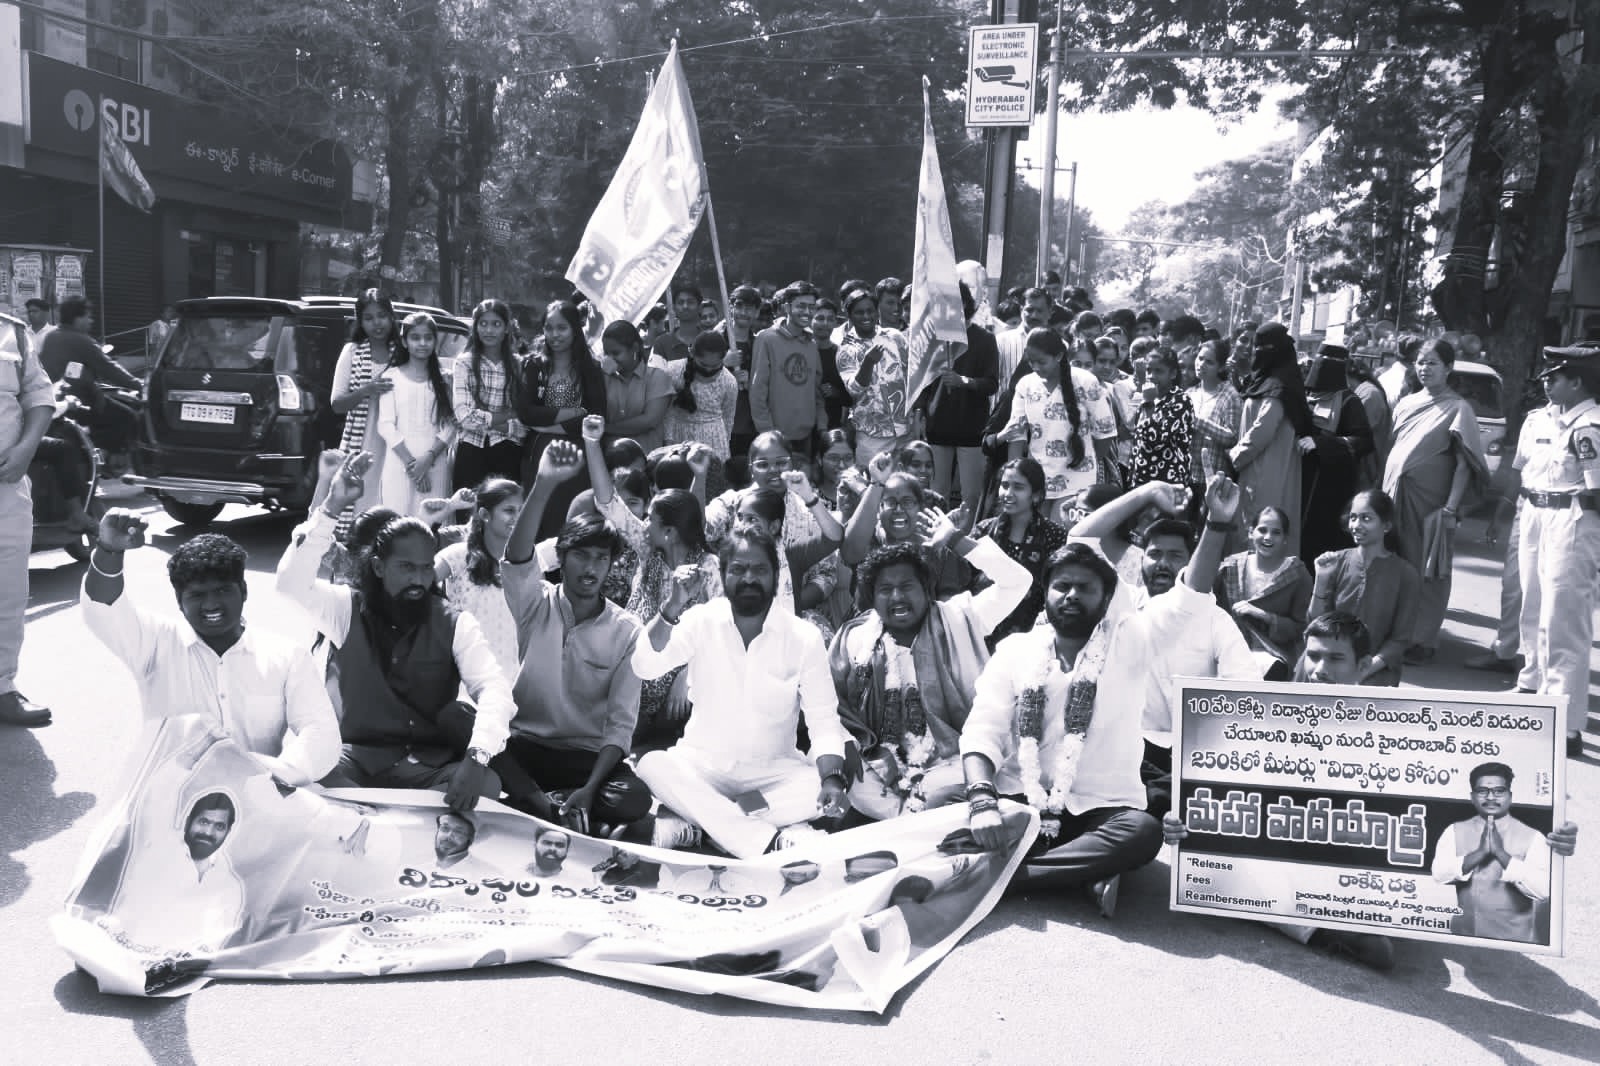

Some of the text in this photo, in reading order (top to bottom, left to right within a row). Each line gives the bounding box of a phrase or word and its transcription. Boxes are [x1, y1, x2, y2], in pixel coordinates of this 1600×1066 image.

[982, 31, 1026, 40] AREA UNDER
[982, 41, 1025, 50] ELECTRONIC
[977, 51, 1028, 60] SURVEILLANCE
[974, 103, 1025, 113] CITY POLICE
[975, 95, 1025, 104] HYDERABAD
[102, 98, 150, 146] SBI
[291, 168, 337, 189] e-Corner
[1237, 697, 1265, 720] కోట్ల
[1335, 701, 1362, 722] ఫీజు
[1487, 713, 1543, 731] విడుదల
[1224, 723, 1500, 756] చేయాలని ఖమ్మం నుండి హైదరాబాద్ వరకు
[1263, 752, 1316, 782] మీటర్లు
[1186, 787, 1427, 867] మహా పాదయాత్ర
[1186, 873, 1211, 885] Fees
[1338, 871, 1418, 900] రాకేష్ దత్త
[1309, 907, 1451, 930] rakeshdatta_official
